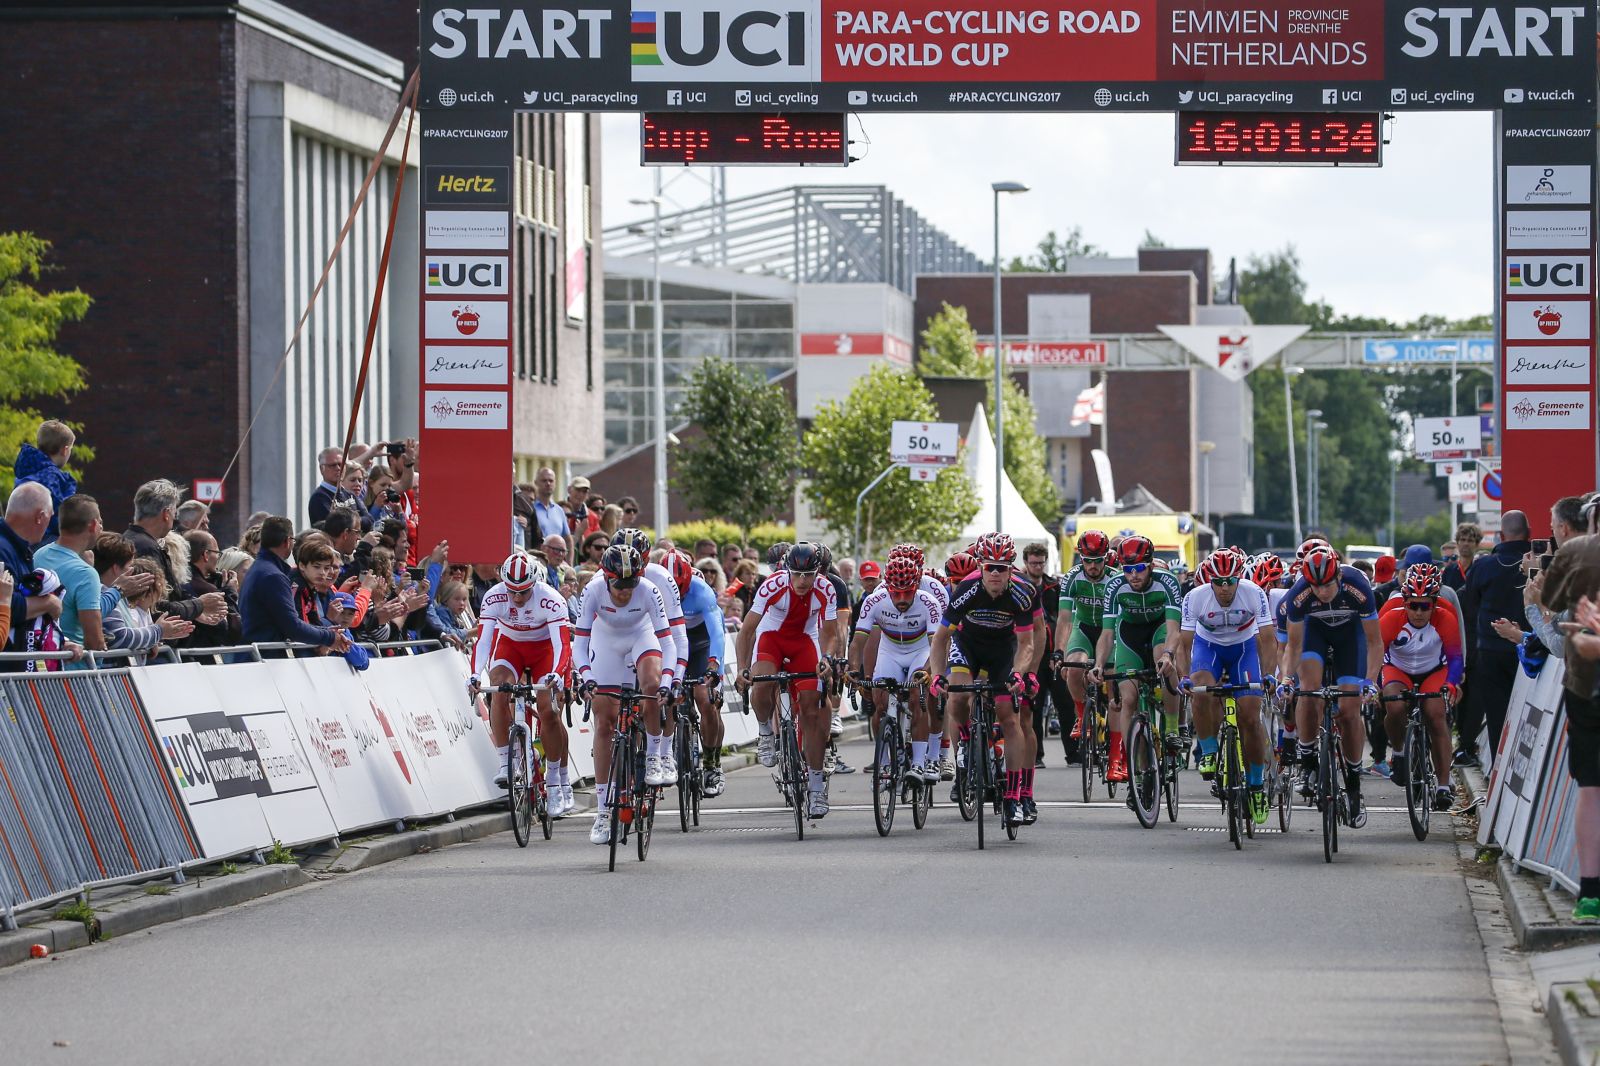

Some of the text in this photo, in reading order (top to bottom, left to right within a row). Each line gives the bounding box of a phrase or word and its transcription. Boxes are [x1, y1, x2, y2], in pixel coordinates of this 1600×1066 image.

[835, 10, 1141, 34] PARA-CYCLING ROAD
[1172, 10, 1279, 34] EMMEN
[1288, 9, 1350, 21] PROVINCIE
[429, 9, 612, 59] START
[1288, 22, 1342, 34] DRENTHE
[1401, 6, 1585, 58] START
[662, 11, 805, 66] UCI
[834, 42, 1009, 67] WORLD CUP
[1172, 41, 1367, 66] NETHERLANDS
[459, 90, 494, 103] uci.ch
[543, 91, 638, 105] UCI_paracycling
[686, 91, 706, 104] UCI
[755, 91, 818, 106] uci_cycling
[871, 90, 918, 104] tv.uci.ch
[949, 91, 1062, 103] #PARACYCLING2017
[1115, 89, 1149, 103] uci.ch
[1198, 90, 1293, 105] UCI_paracycling
[1341, 90, 1362, 103] UCI
[1410, 90, 1475, 105] uci_cycling
[1527, 89, 1575, 102] tv.uci.ch
[424, 129, 509, 138] #PARACYCLING2017
[1189, 121, 1376, 153] 16:01:34
[1505, 128, 1591, 138] #PARACYCLING2017
[442, 264, 502, 287] UCI
[1523, 263, 1584, 287] UCI
[457, 401, 502, 409] Gemeente
[1538, 401, 1584, 409] Gemeente
[908, 436, 929, 450] 50
[1432, 432, 1465, 446] 50 M
[1458, 482, 1477, 491] 100
[1061, 564, 1081, 592] IRELAND
[759, 575, 785, 598] CCC
[1160, 574, 1182, 604] IRELAND
[1104, 578, 1122, 612] IRELAND
[540, 598, 561, 612] CCC
[859, 593, 887, 619] Cofidis
[919, 594, 939, 624] Cofidis
[168, 732, 211, 787] UCI
